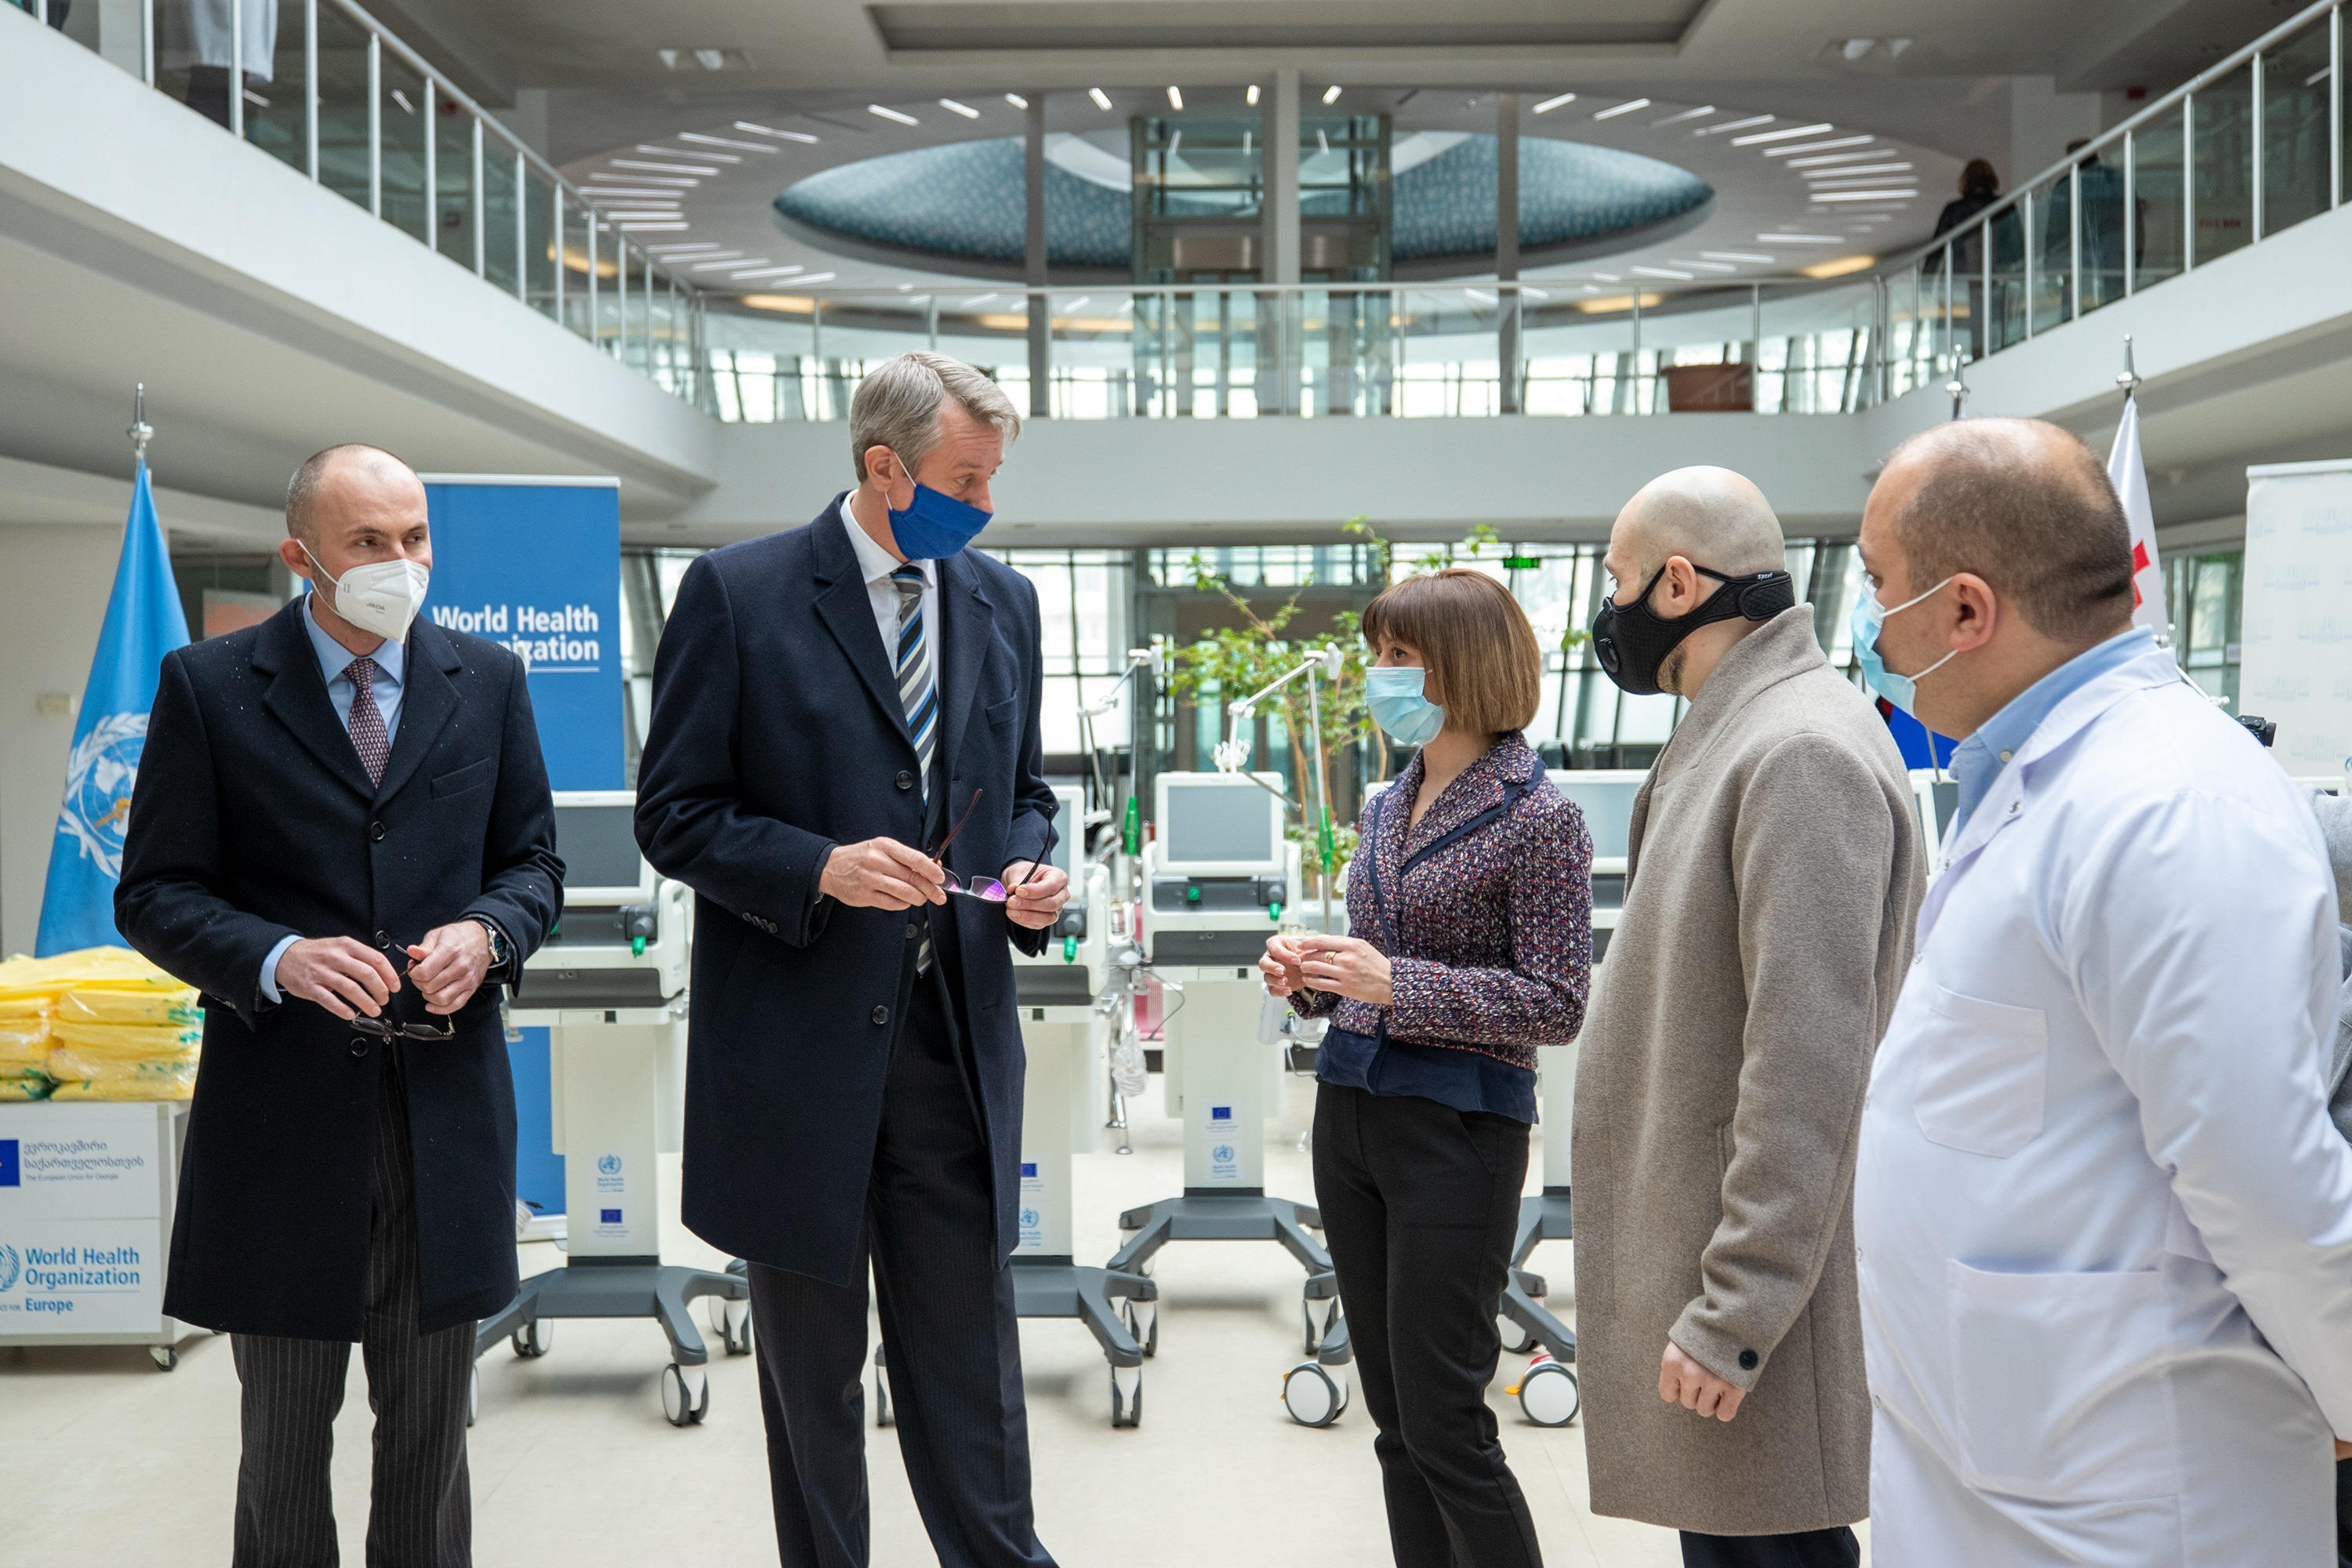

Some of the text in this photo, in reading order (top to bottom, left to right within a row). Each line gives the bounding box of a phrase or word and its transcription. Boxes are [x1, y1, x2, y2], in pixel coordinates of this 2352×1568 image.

[433, 604, 599, 633] World Health
[24, 1139, 107, 1155] ევროკავშირი
[24, 1156, 144, 1171] საქართველოსთვის
[25, 1247, 140, 1265] World Health
[25, 1268, 140, 1290] Organization
[25, 1298, 74, 1315] Europe
